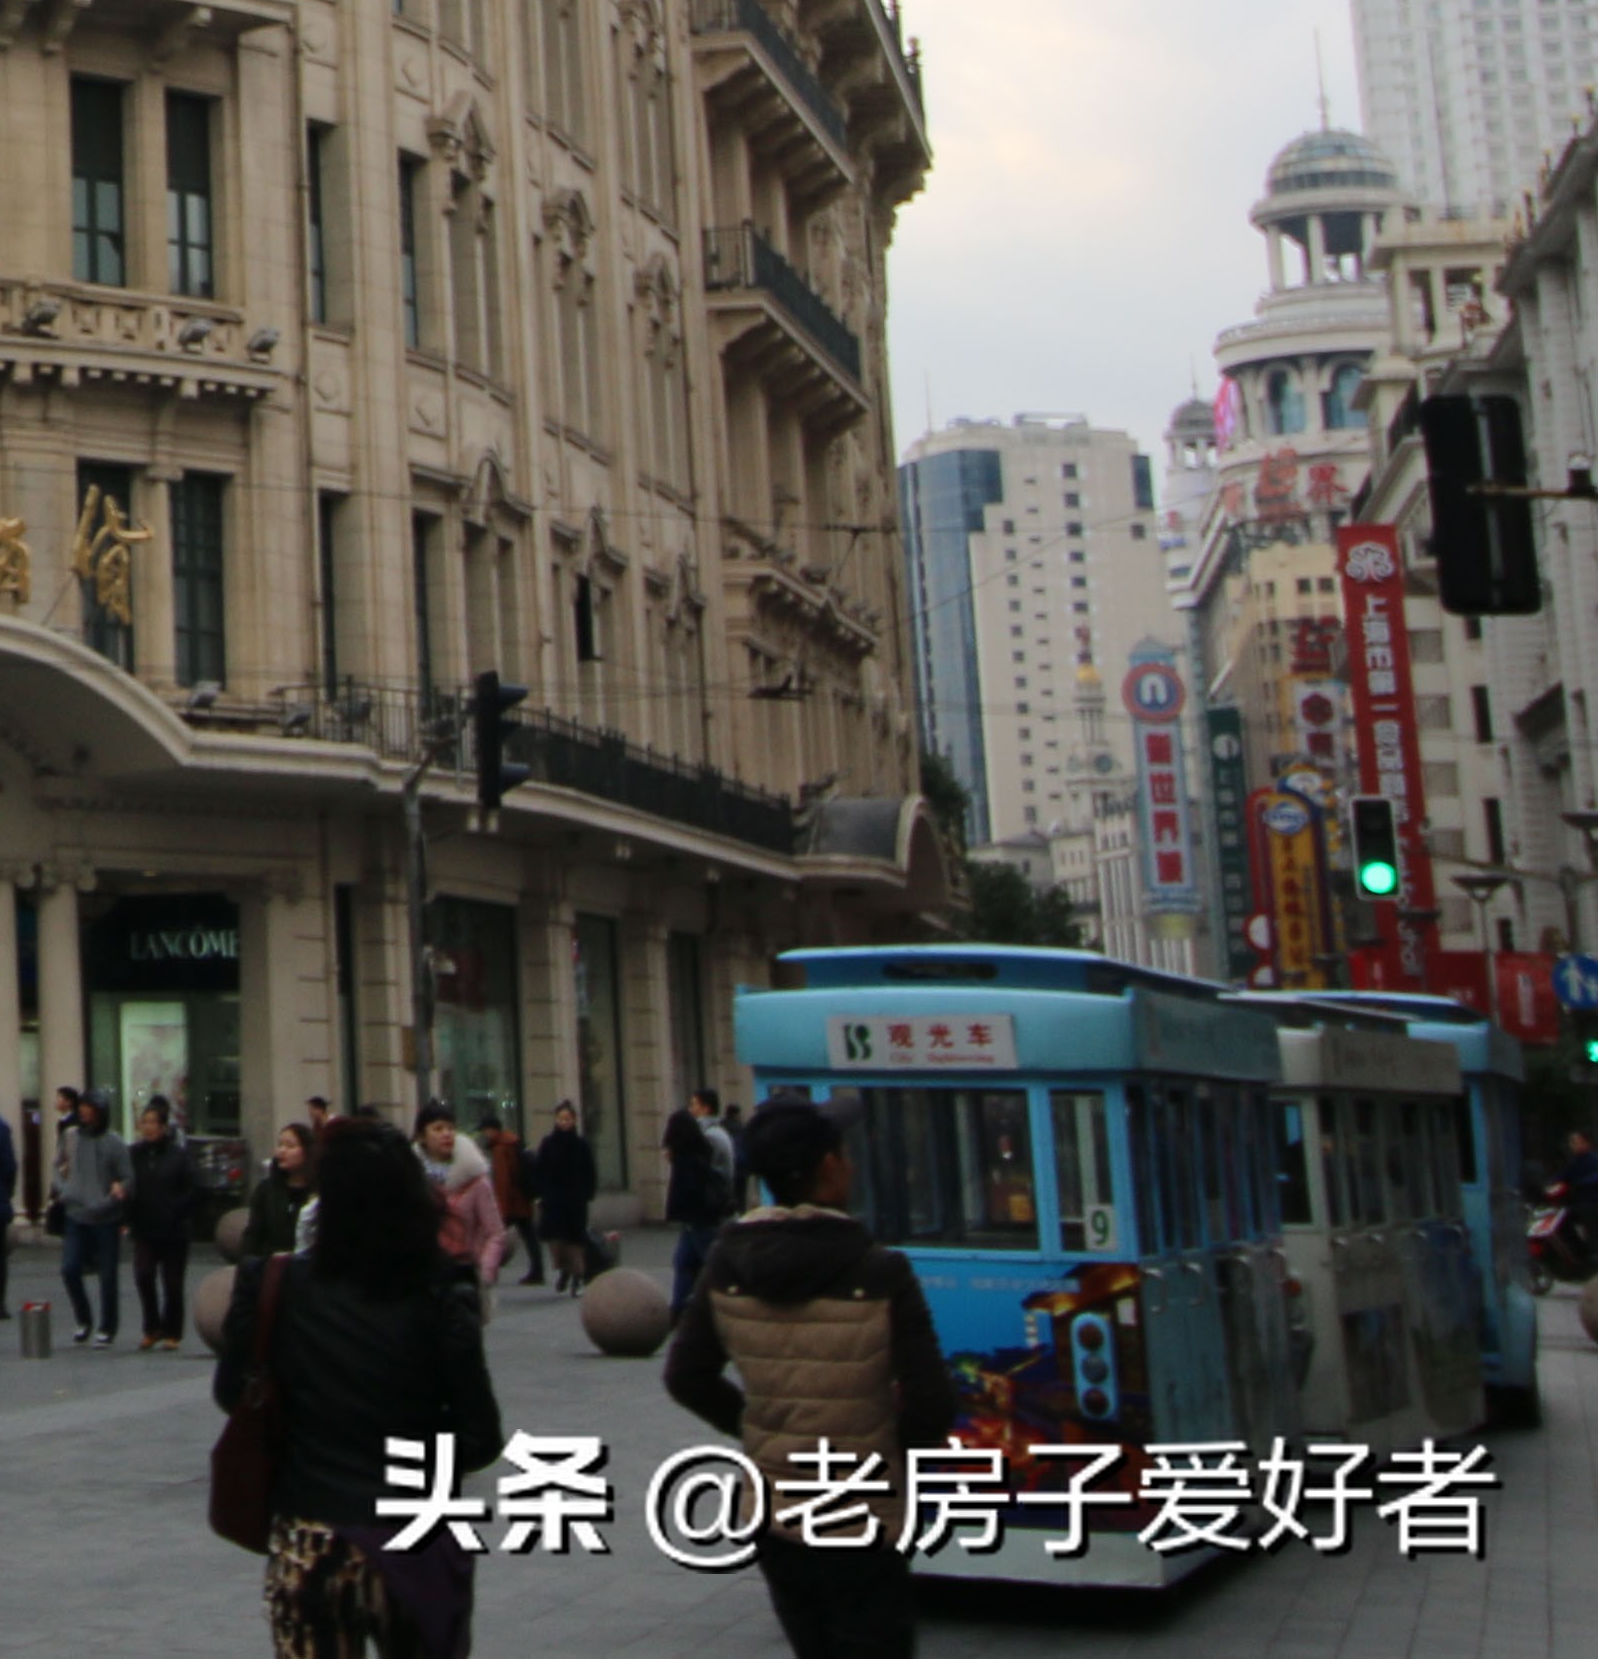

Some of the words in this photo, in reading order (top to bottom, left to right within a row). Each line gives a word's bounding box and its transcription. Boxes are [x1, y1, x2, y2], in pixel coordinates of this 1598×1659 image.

[887, 1023, 994, 1049] 观光车
[1091, 1210, 1110, 1247] 9
